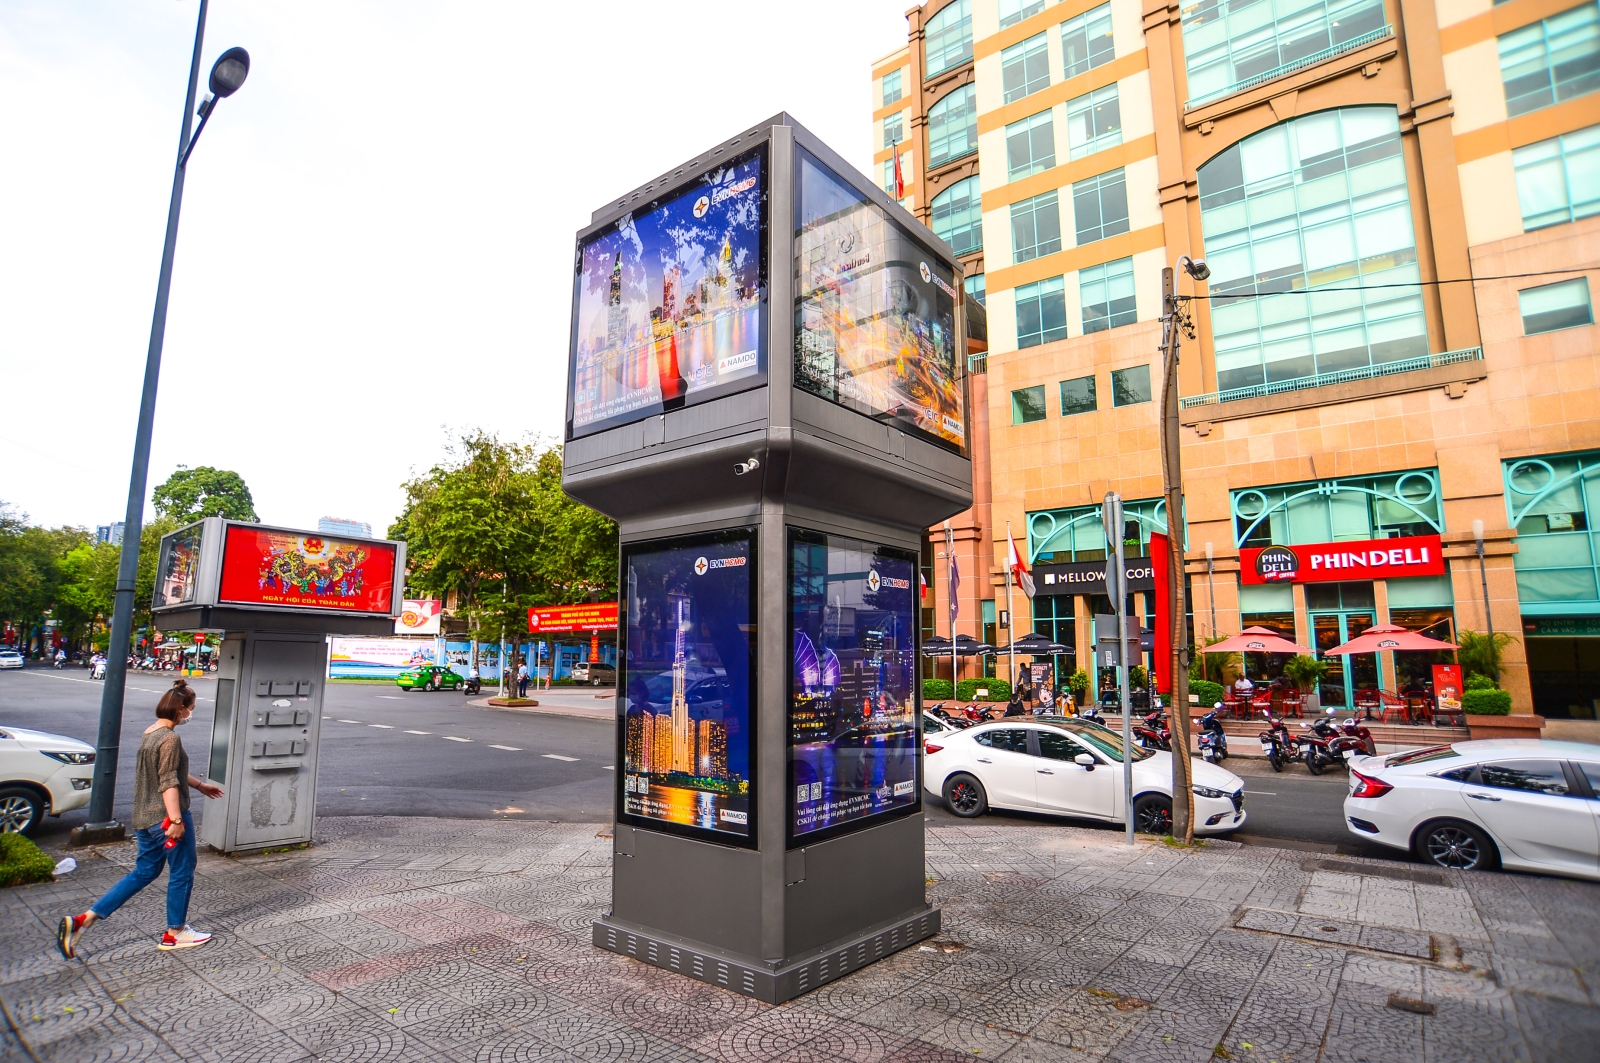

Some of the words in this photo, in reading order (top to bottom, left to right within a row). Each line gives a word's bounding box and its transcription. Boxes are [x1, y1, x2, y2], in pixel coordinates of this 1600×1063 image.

[728, 352, 756, 366] NAMDO
[626, 386, 654, 400] EVNHCMC
[710, 557, 746, 568] EVNHCMC
[1262, 554, 1291, 563] PHIN
[1310, 547, 1429, 570] PHINDELI
[1263, 563, 1292, 572] DELI
[882, 576, 909, 589] EVNHCMC
[849, 794, 870, 804] EVNHCMC
[726, 811, 746, 820] NAMDO
[797, 817, 812, 825] CSKH
